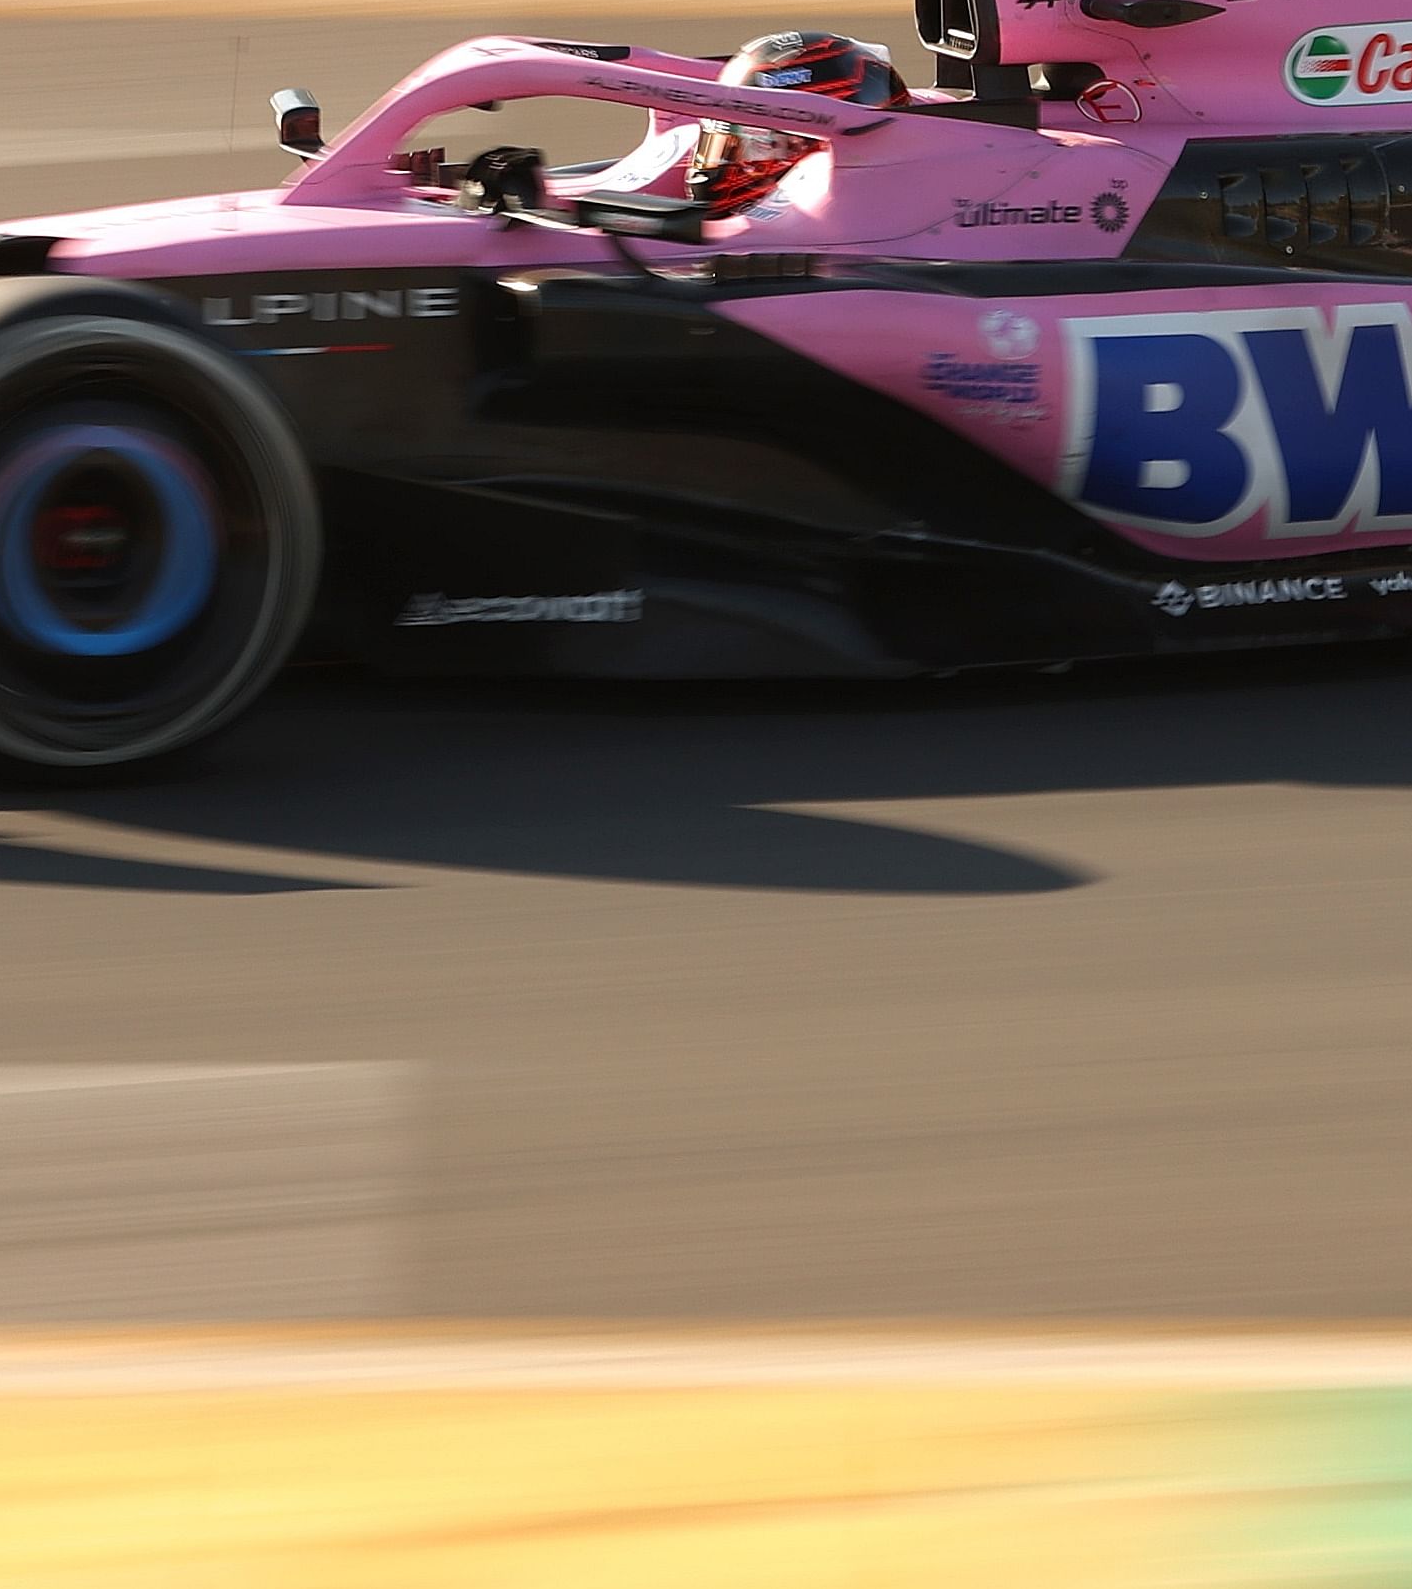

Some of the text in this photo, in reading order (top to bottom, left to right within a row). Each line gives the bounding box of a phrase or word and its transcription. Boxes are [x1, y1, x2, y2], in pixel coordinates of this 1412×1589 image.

[954, 200, 1083, 228] ultimate
[201, 286, 459, 326] LPINE
[1195, 576, 1348, 609] BINANCE
